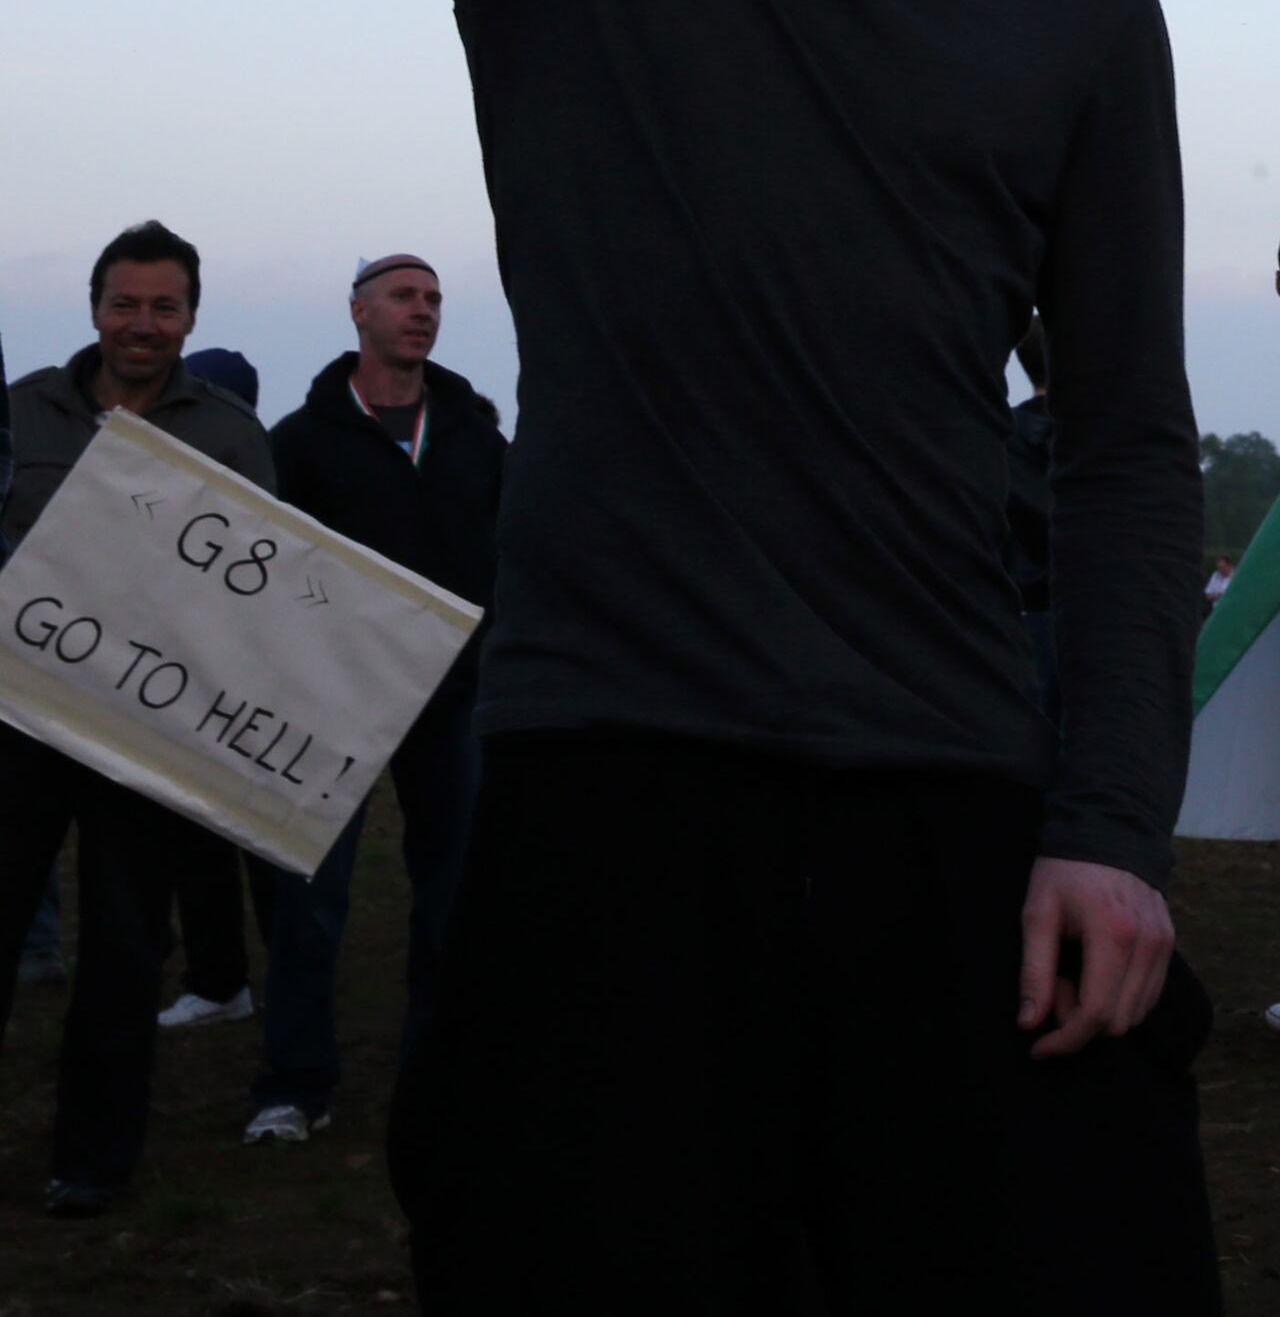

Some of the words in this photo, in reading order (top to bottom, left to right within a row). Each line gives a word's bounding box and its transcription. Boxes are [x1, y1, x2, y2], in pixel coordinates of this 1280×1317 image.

[176, 512, 279, 596] G8
[14, 596, 103, 663] GO
[114, 639, 189, 710] TO
